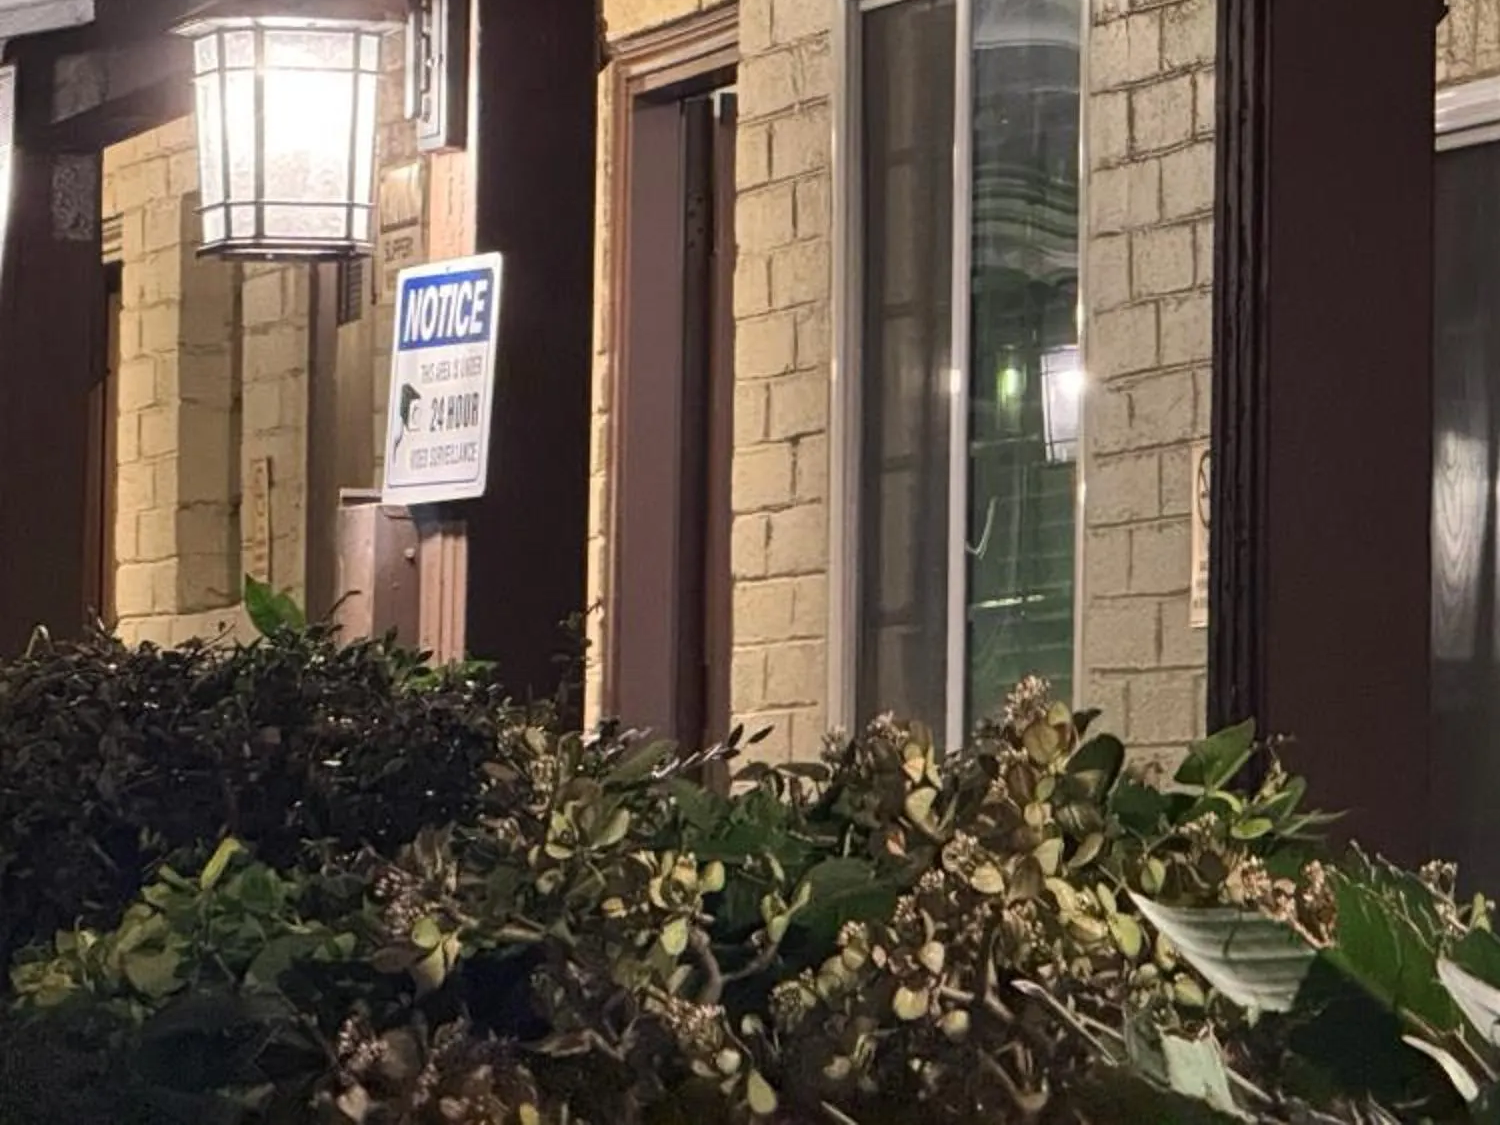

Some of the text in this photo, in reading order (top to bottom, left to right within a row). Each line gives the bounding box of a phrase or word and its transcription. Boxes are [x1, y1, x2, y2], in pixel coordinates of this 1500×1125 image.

[403, 279, 488, 342] NOTICE
[430, 392, 479, 433] 24 HOUR
